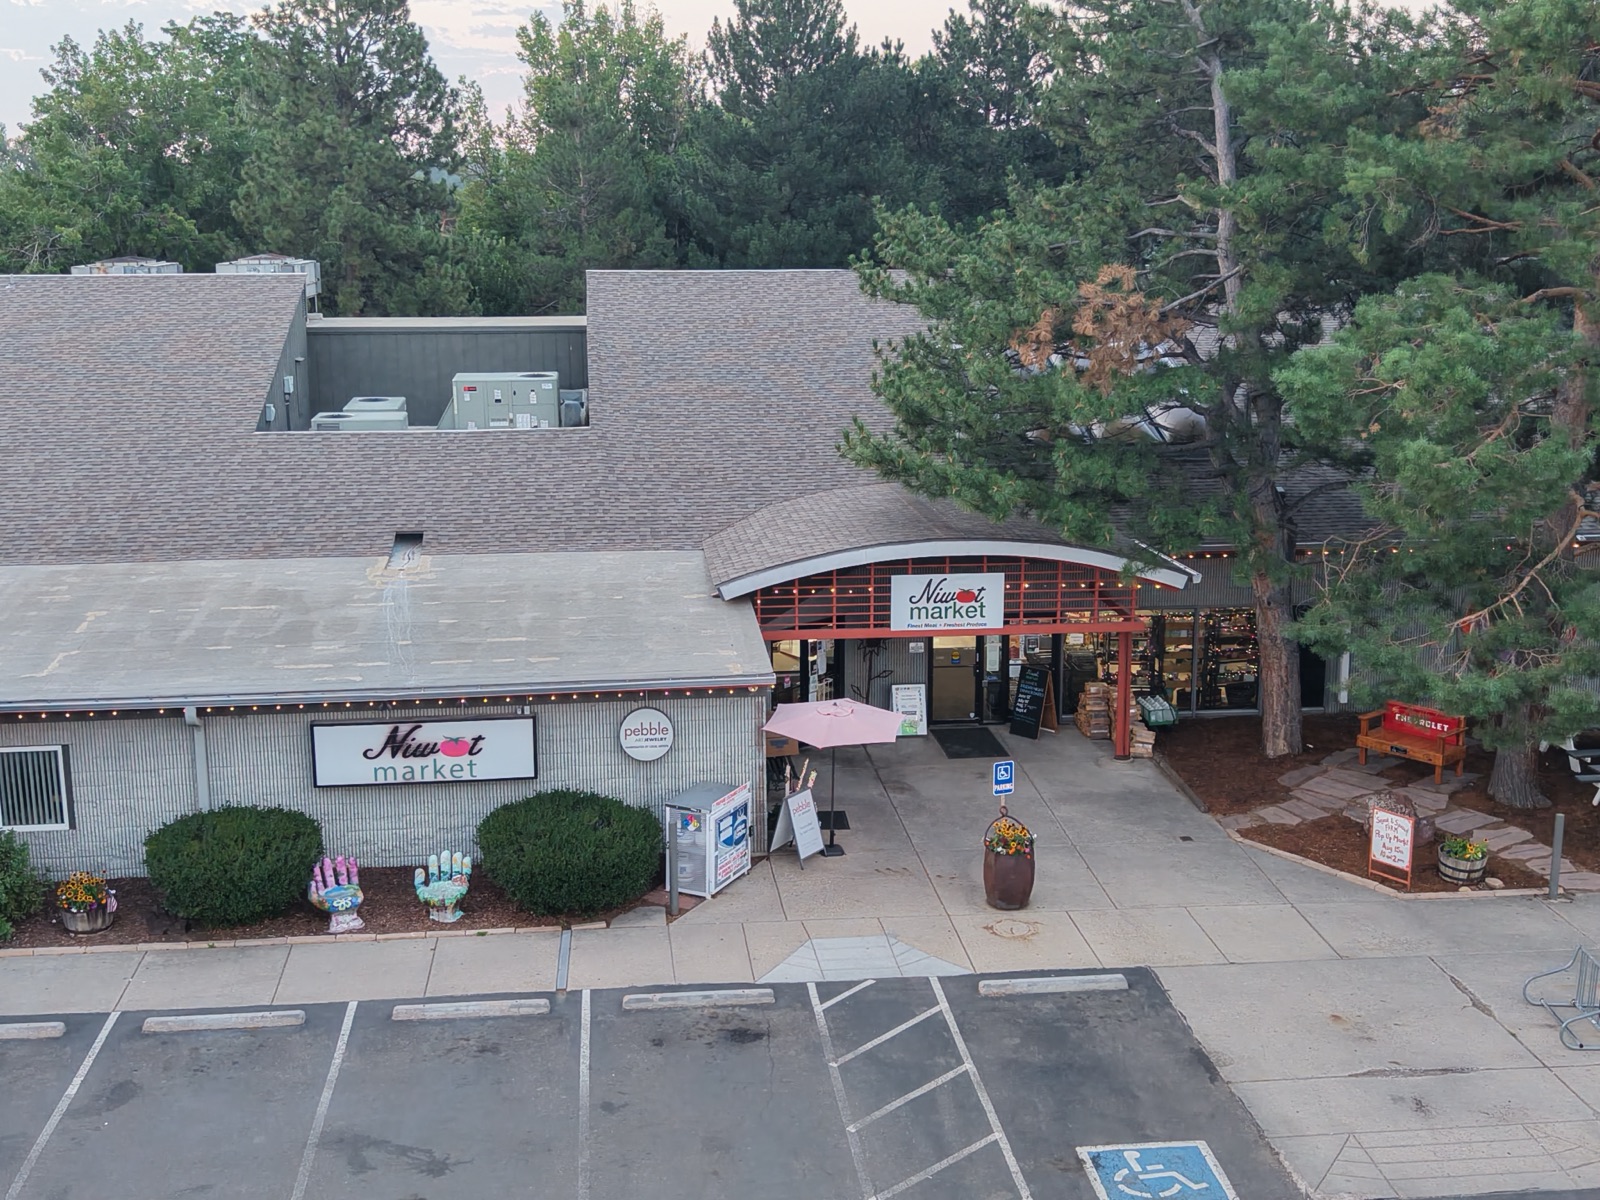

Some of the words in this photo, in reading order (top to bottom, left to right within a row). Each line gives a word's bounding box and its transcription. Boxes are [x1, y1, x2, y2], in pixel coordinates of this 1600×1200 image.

[910, 602, 986, 620] market
[624, 722, 668, 740] pebble
[373, 758, 477, 781] market
[994, 783, 1013, 791] PARKING
[792, 799, 811, 817] pebble
[1375, 830, 1384, 841] Pop
[1386, 832, 1392, 844] Up
[1382, 842, 1392, 854] Aug
